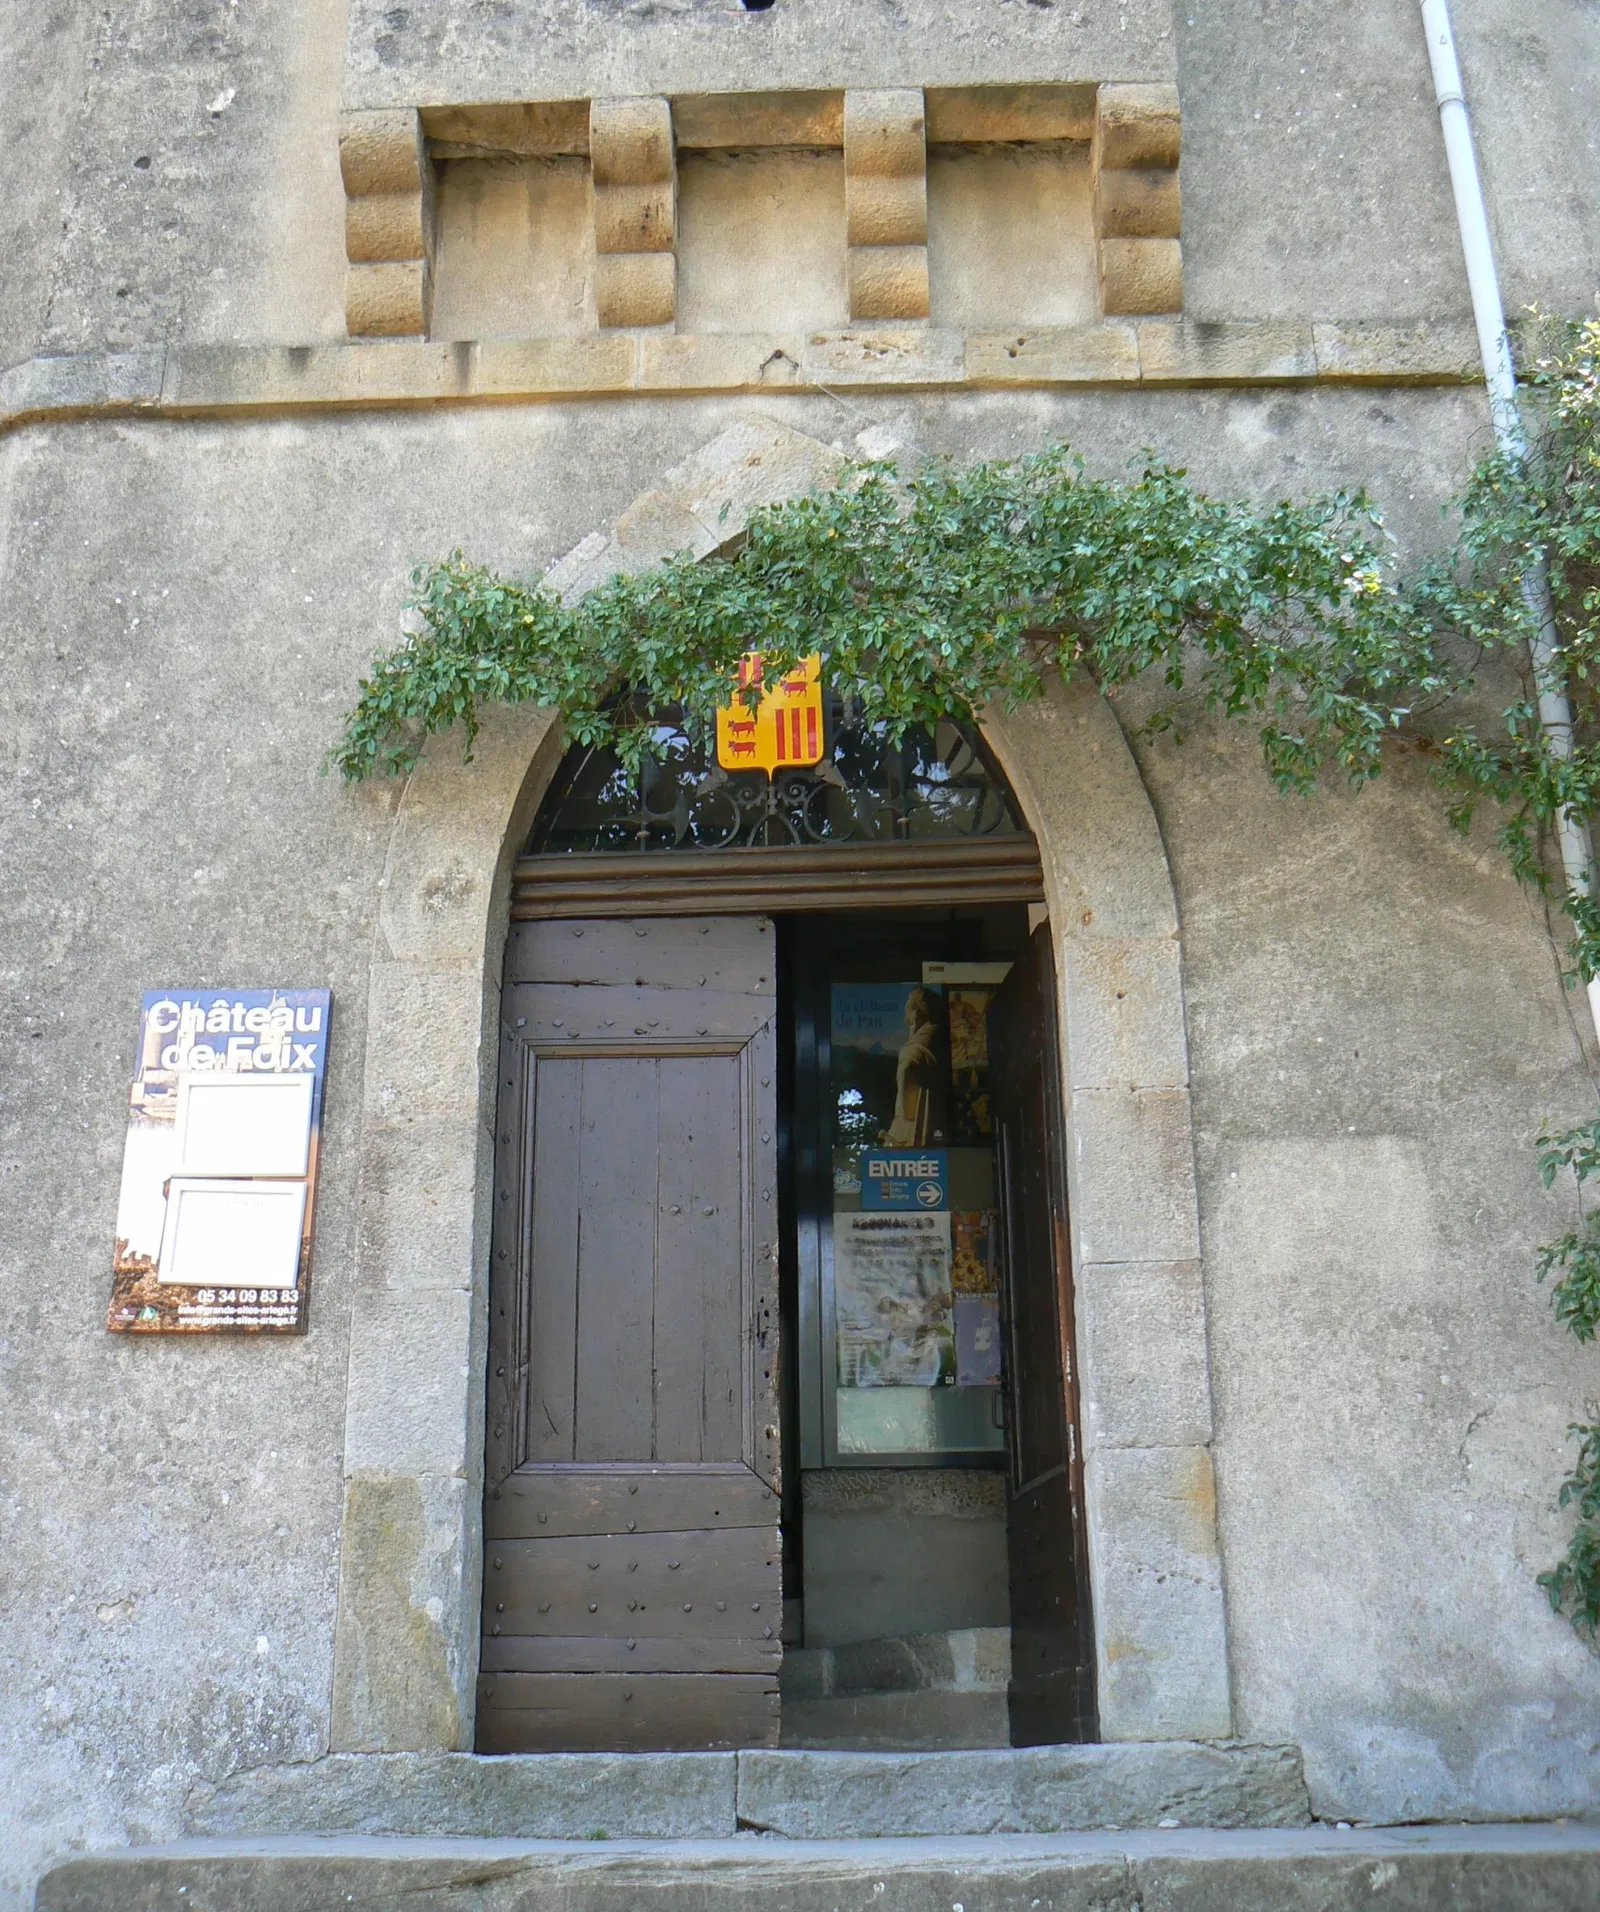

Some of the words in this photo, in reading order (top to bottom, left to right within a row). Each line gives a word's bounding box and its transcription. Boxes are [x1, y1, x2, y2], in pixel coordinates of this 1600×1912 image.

[149, 998, 322, 1034] Château
[836, 1013, 853, 1028] de
[161, 1031, 216, 1070] de
[226, 1035, 318, 1070] Foix
[869, 1155, 940, 1177] ENTRÉE
[197, 1289, 216, 1303] 05
[218, 1289, 236, 1303] 34
[239, 1289, 258, 1303] 09
[260, 1289, 278, 1303] 83
[281, 1289, 299, 1303] 83
[178, 1315, 298, 1326] www.grands-sites-ariege.fr
